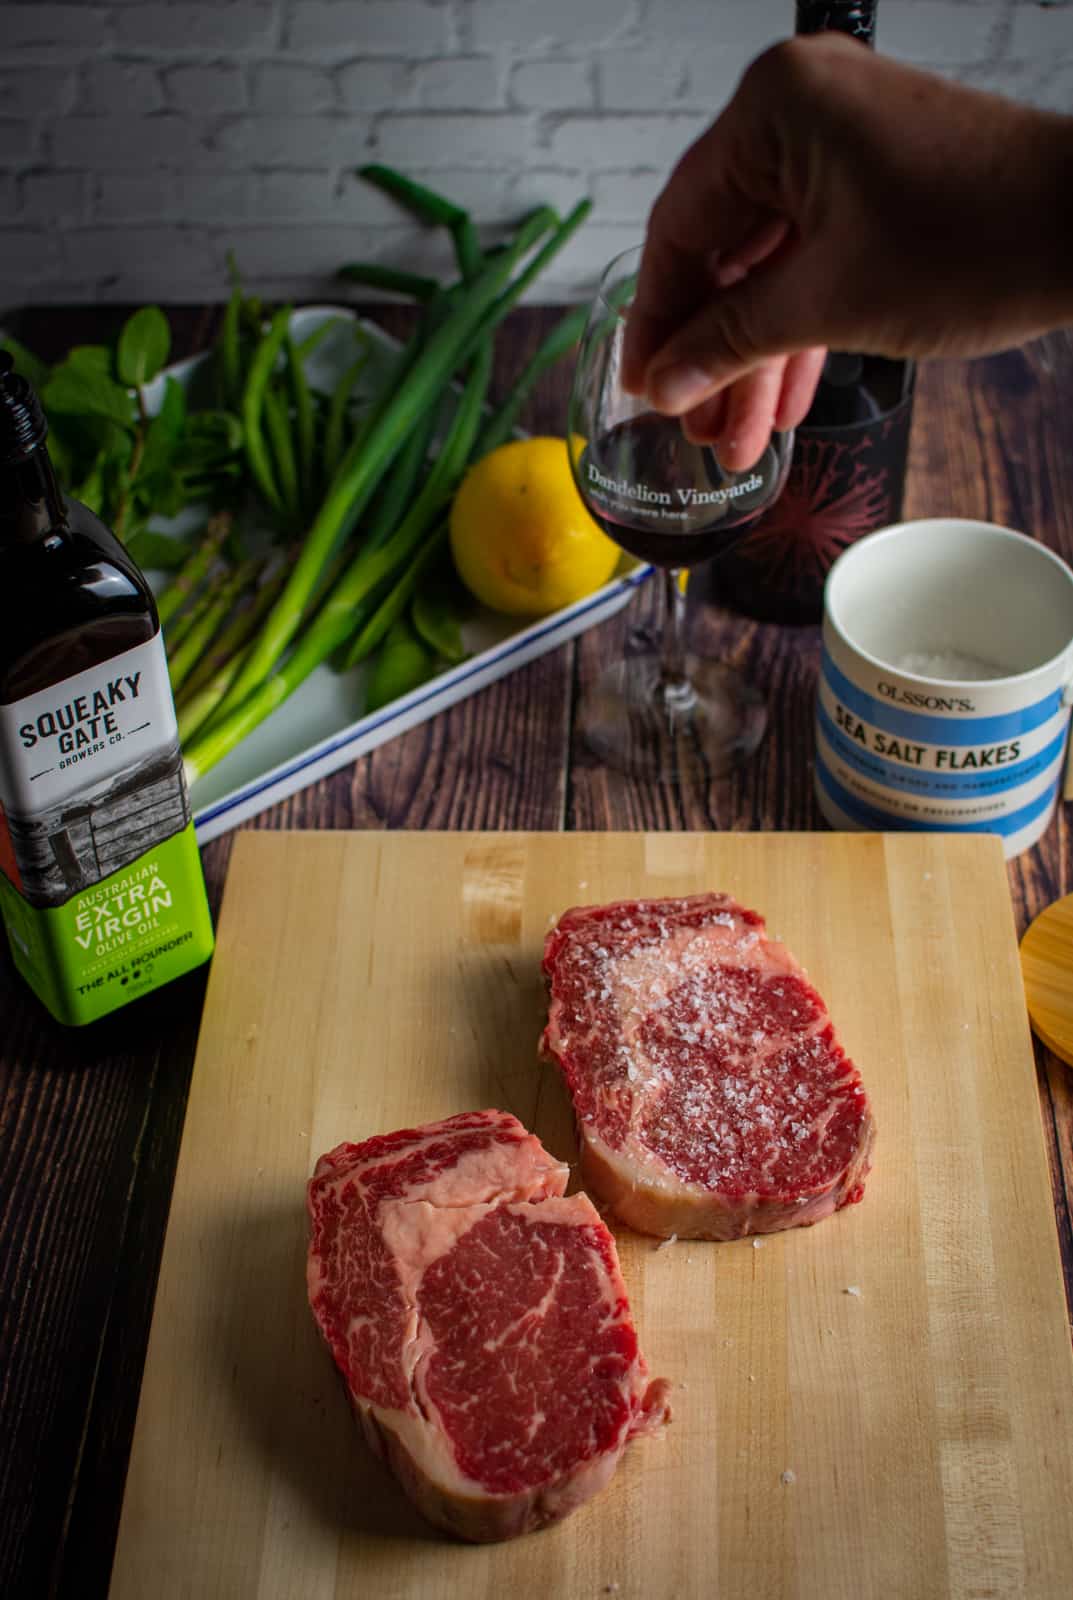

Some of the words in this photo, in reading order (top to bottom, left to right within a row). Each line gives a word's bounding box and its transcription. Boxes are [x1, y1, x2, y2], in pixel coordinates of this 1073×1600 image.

[588, 464, 671, 504] Dandelion
[678, 474, 763, 505] Vineyards
[19, 671, 141, 748] SQUEAKY
[57, 711, 118, 754] GATE
[59, 741, 105, 769] GROWERS
[109, 732, 126, 745] CO.
[835, 704, 866, 744] SEA
[873, 732, 928, 765] SALT
[935, 741, 1020, 768] FLAKES
[75, 876, 167, 931] EXTRA
[77, 862, 159, 912] AUSTRALIAN
[74, 890, 172, 950] VIRGIN
[95, 930, 133, 956] OLIVE
[137, 917, 160, 935] OIL
[77, 977, 104, 995] THE
[106, 965, 129, 983] ALL
[131, 931, 193, 967] ROUNDER
